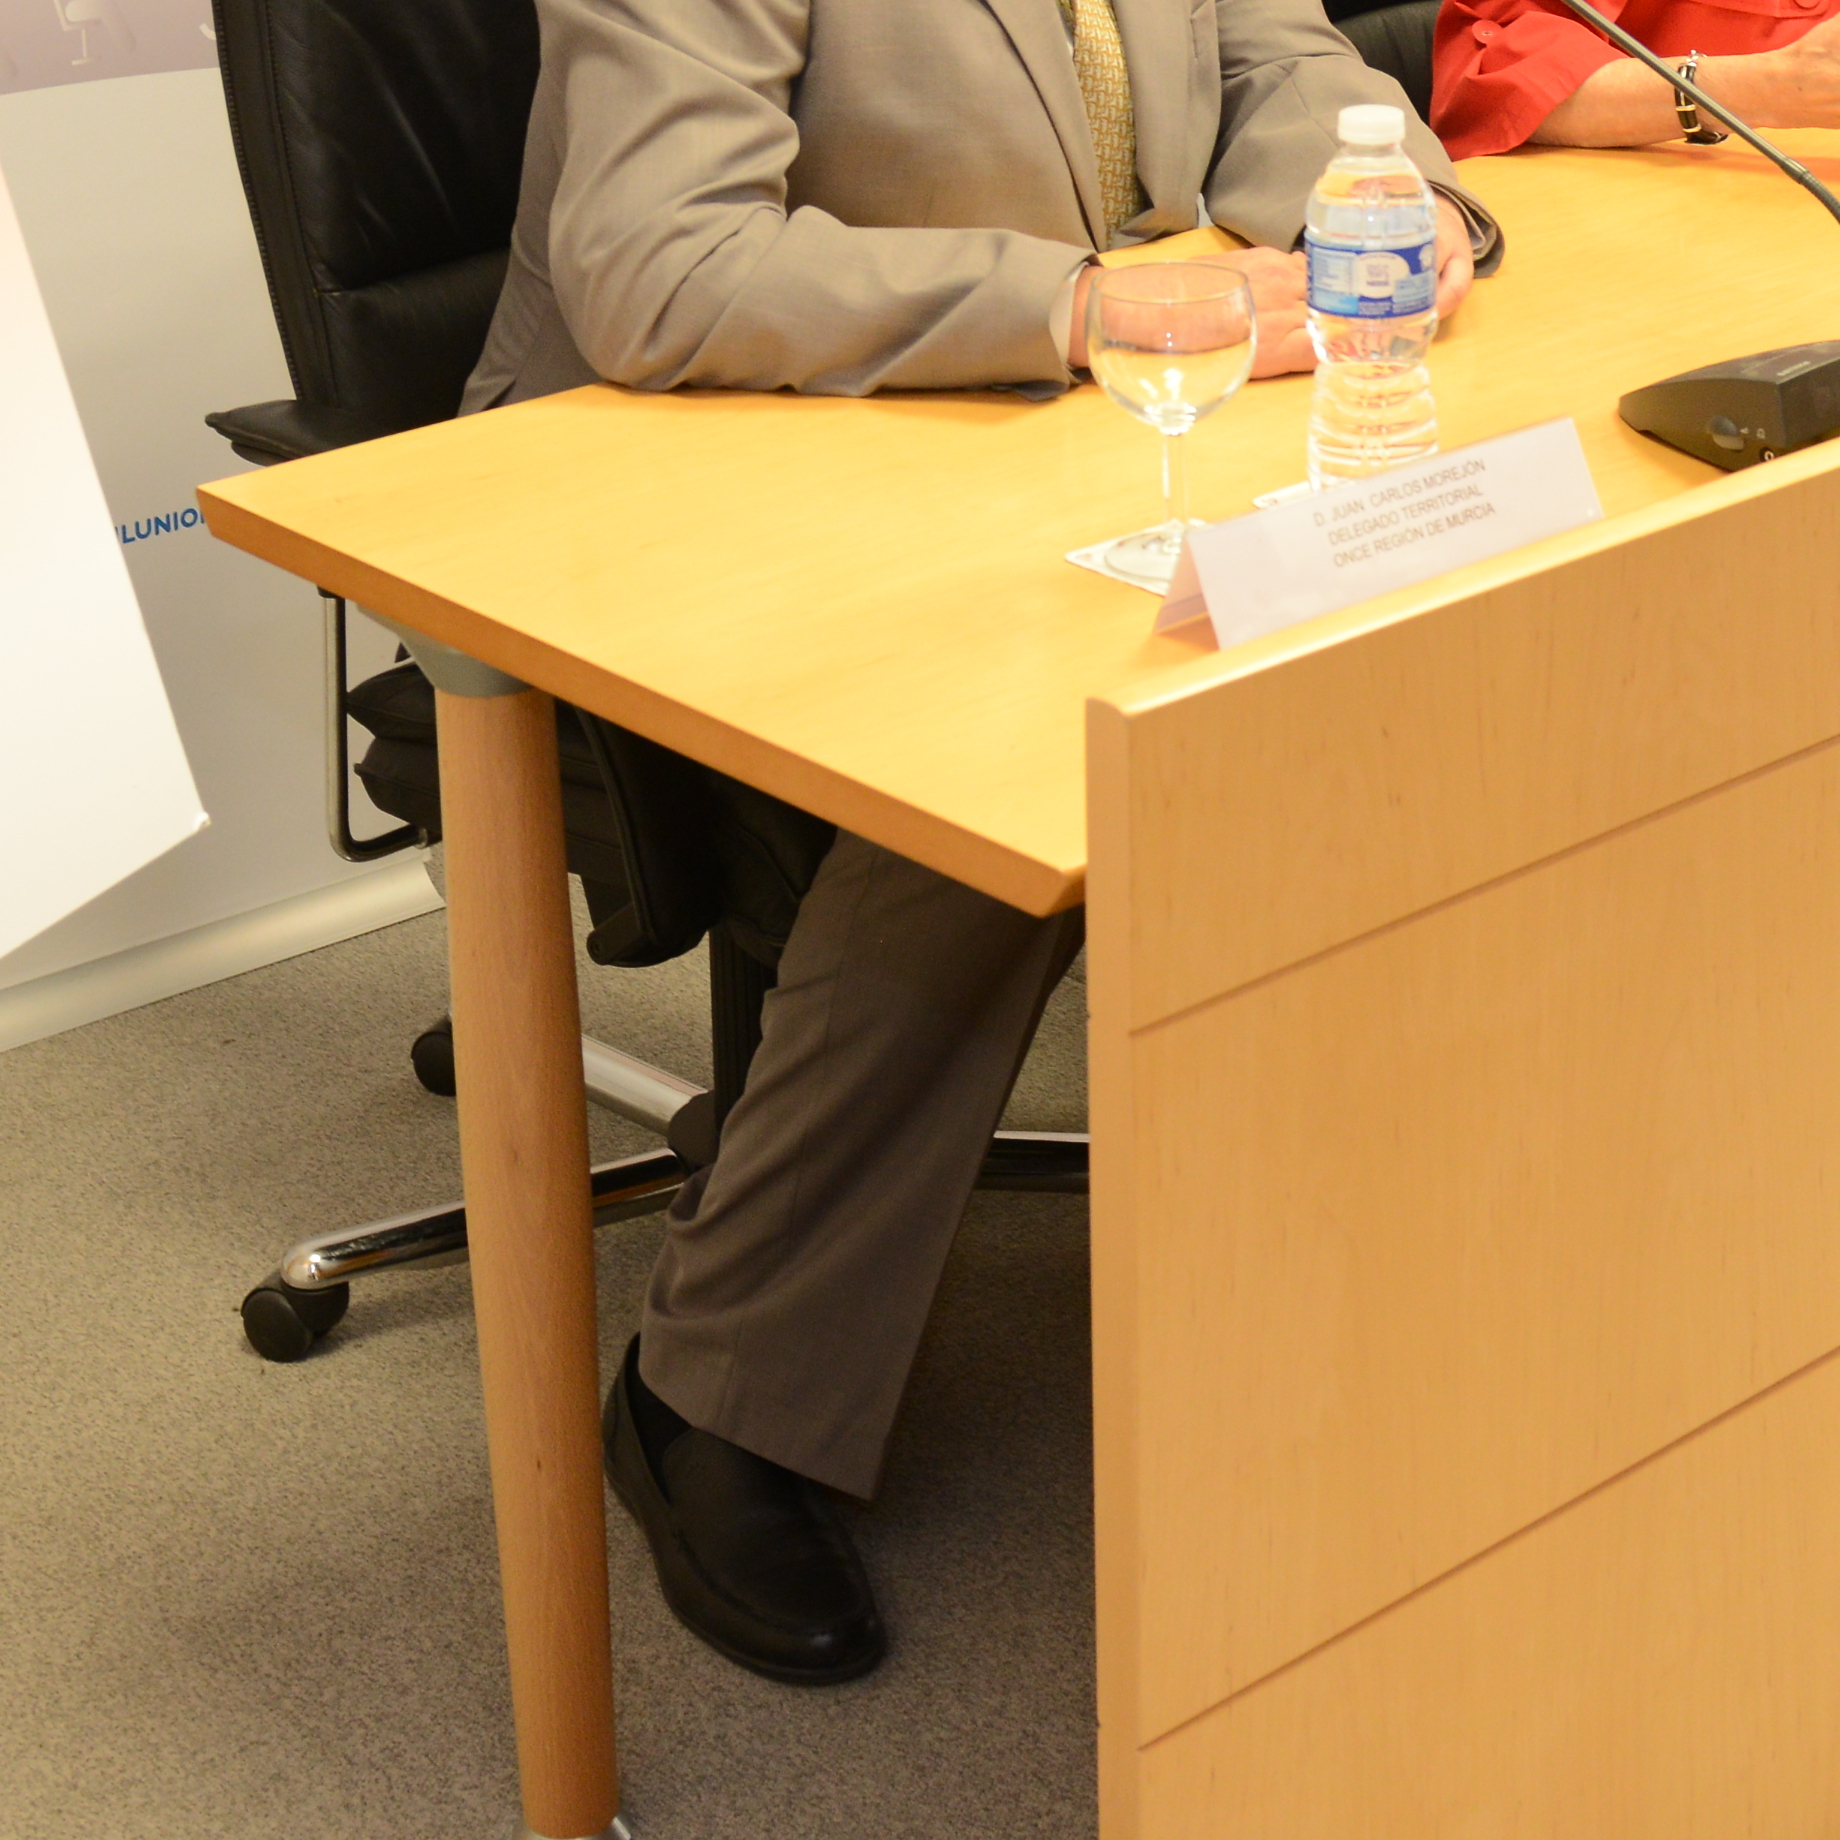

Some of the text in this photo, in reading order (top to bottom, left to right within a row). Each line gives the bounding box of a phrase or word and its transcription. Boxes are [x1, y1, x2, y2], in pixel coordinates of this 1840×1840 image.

[114, 507, 206, 544] LUNIO
[1327, 483, 1484, 546] DELEGADO TERRITORIAL
[1331, 499, 1365, 522] JUAN
[1369, 479, 1423, 508] CARLOS
[1333, 544, 1373, 568] ONCE
[1425, 519, 1445, 537] DE
[1445, 501, 1496, 530] MURCIA
